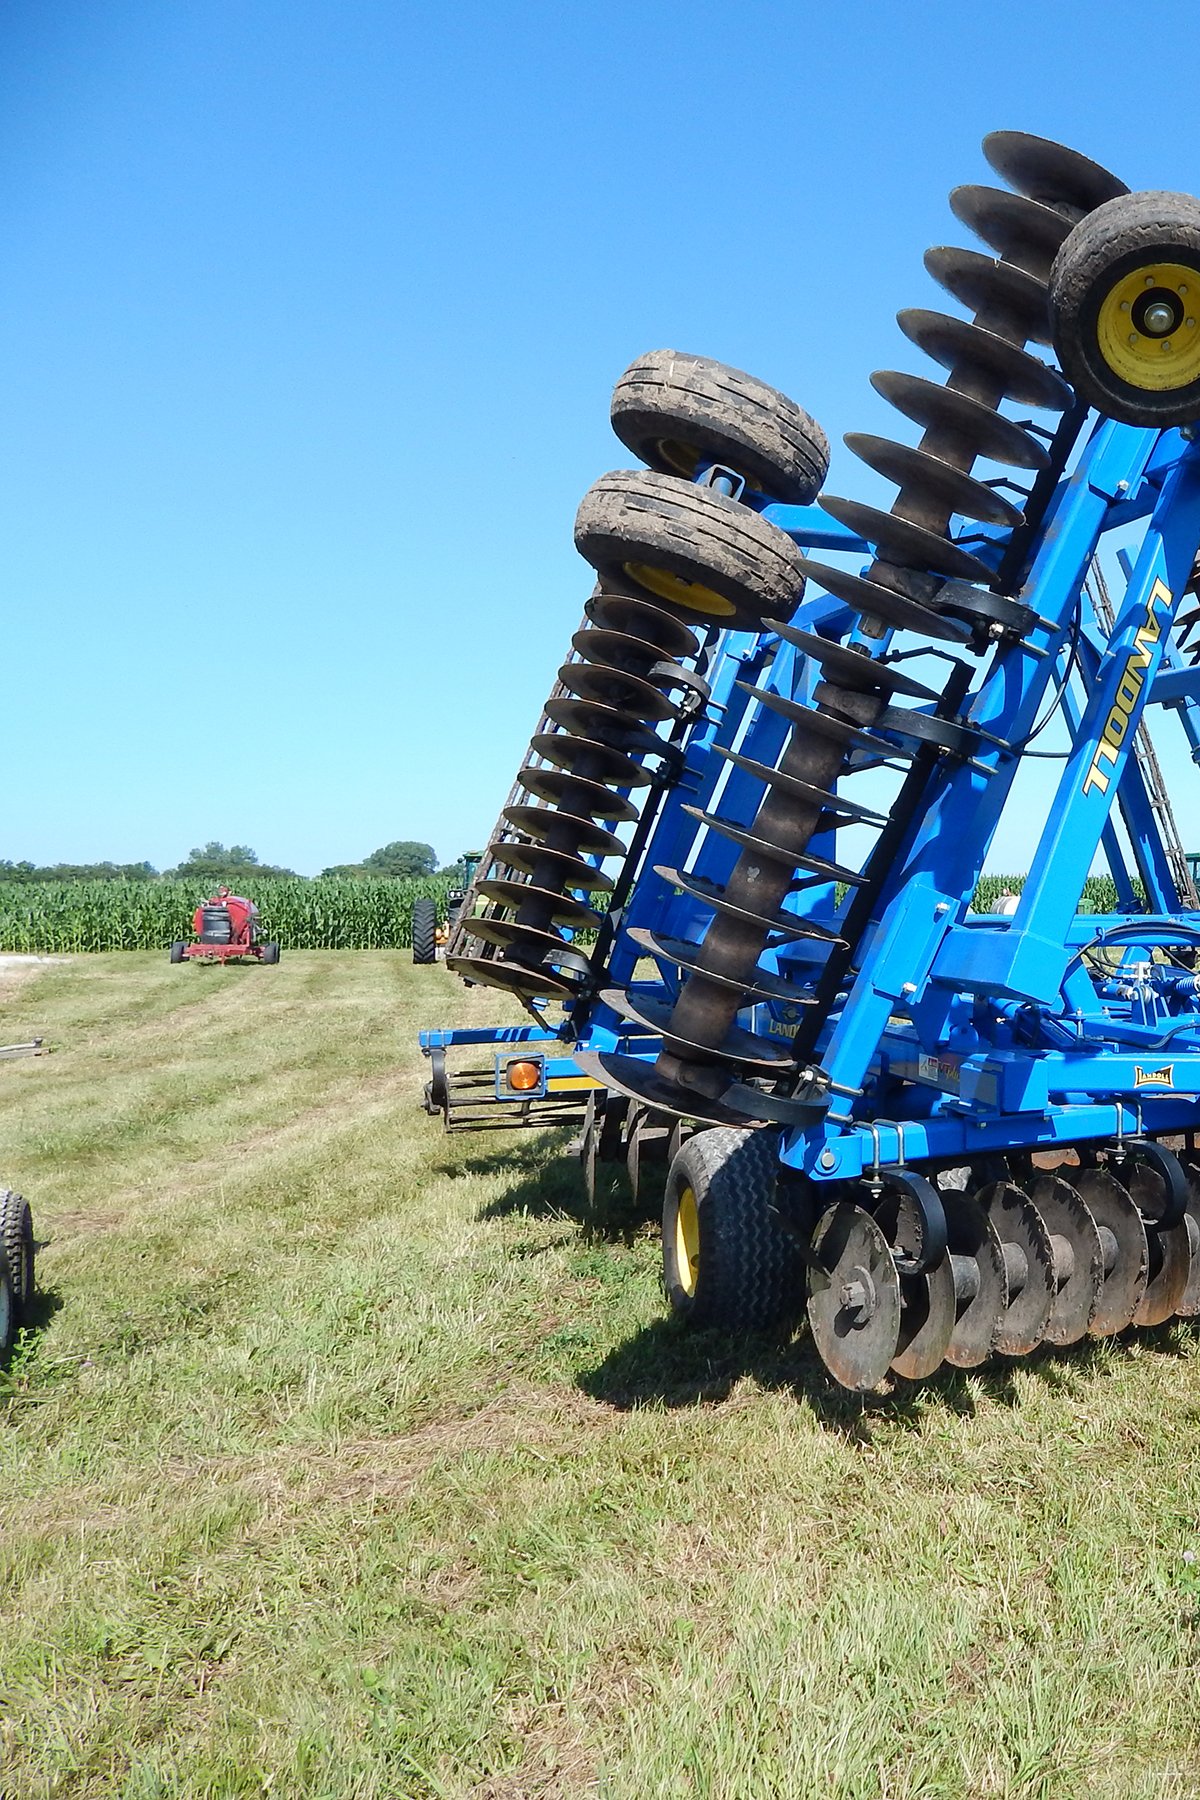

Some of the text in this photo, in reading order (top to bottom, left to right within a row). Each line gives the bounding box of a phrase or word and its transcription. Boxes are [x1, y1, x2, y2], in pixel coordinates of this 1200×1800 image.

[1082, 574, 1173, 797] LANDOLL
[769, 1018, 801, 1039] LAND
[1137, 1068, 1171, 1084] LANDOLL
